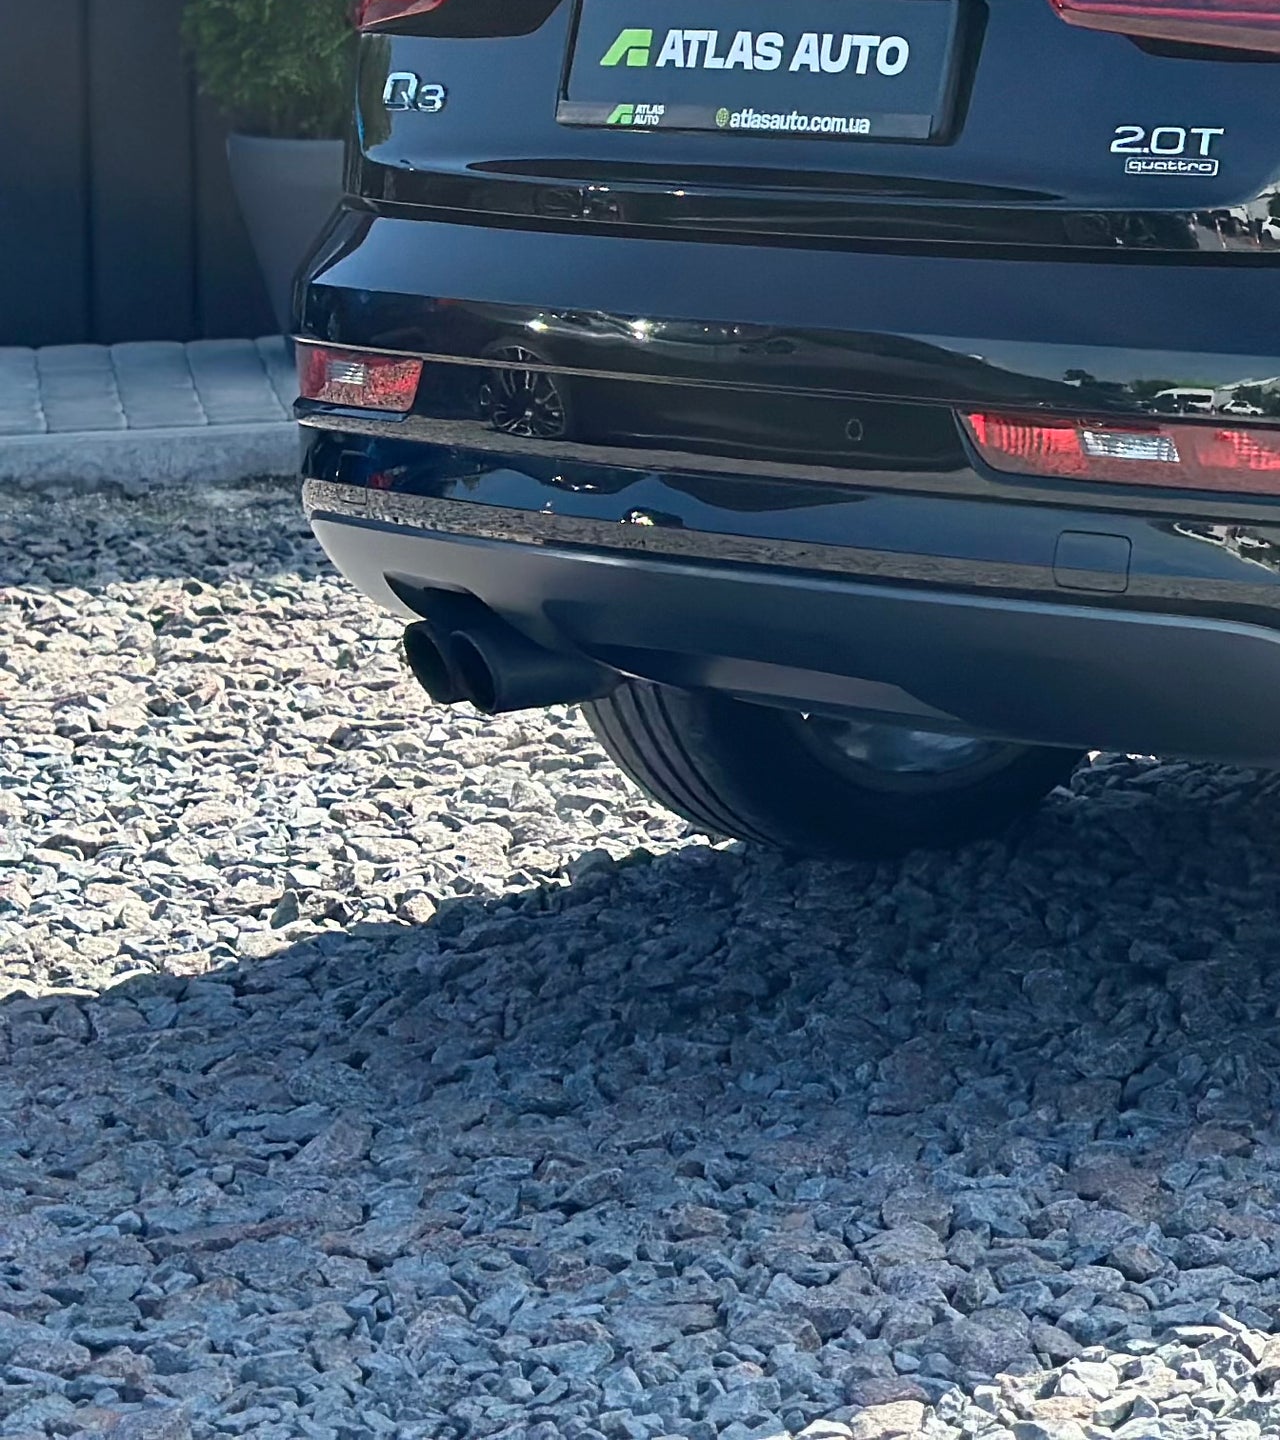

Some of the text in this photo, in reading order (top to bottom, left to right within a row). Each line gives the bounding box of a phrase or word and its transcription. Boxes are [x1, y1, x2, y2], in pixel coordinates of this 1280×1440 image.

[655, 29, 910, 76] ATLAS AUTO
[382, 71, 446, 113] Q3
[633, 114, 660, 125] AUTO
[634, 104, 665, 116] ATLAS
[729, 109, 872, 134] atlasauto.com.ua
[1109, 125, 1225, 156] 2.0T
[1127, 160, 1213, 173] quattro
